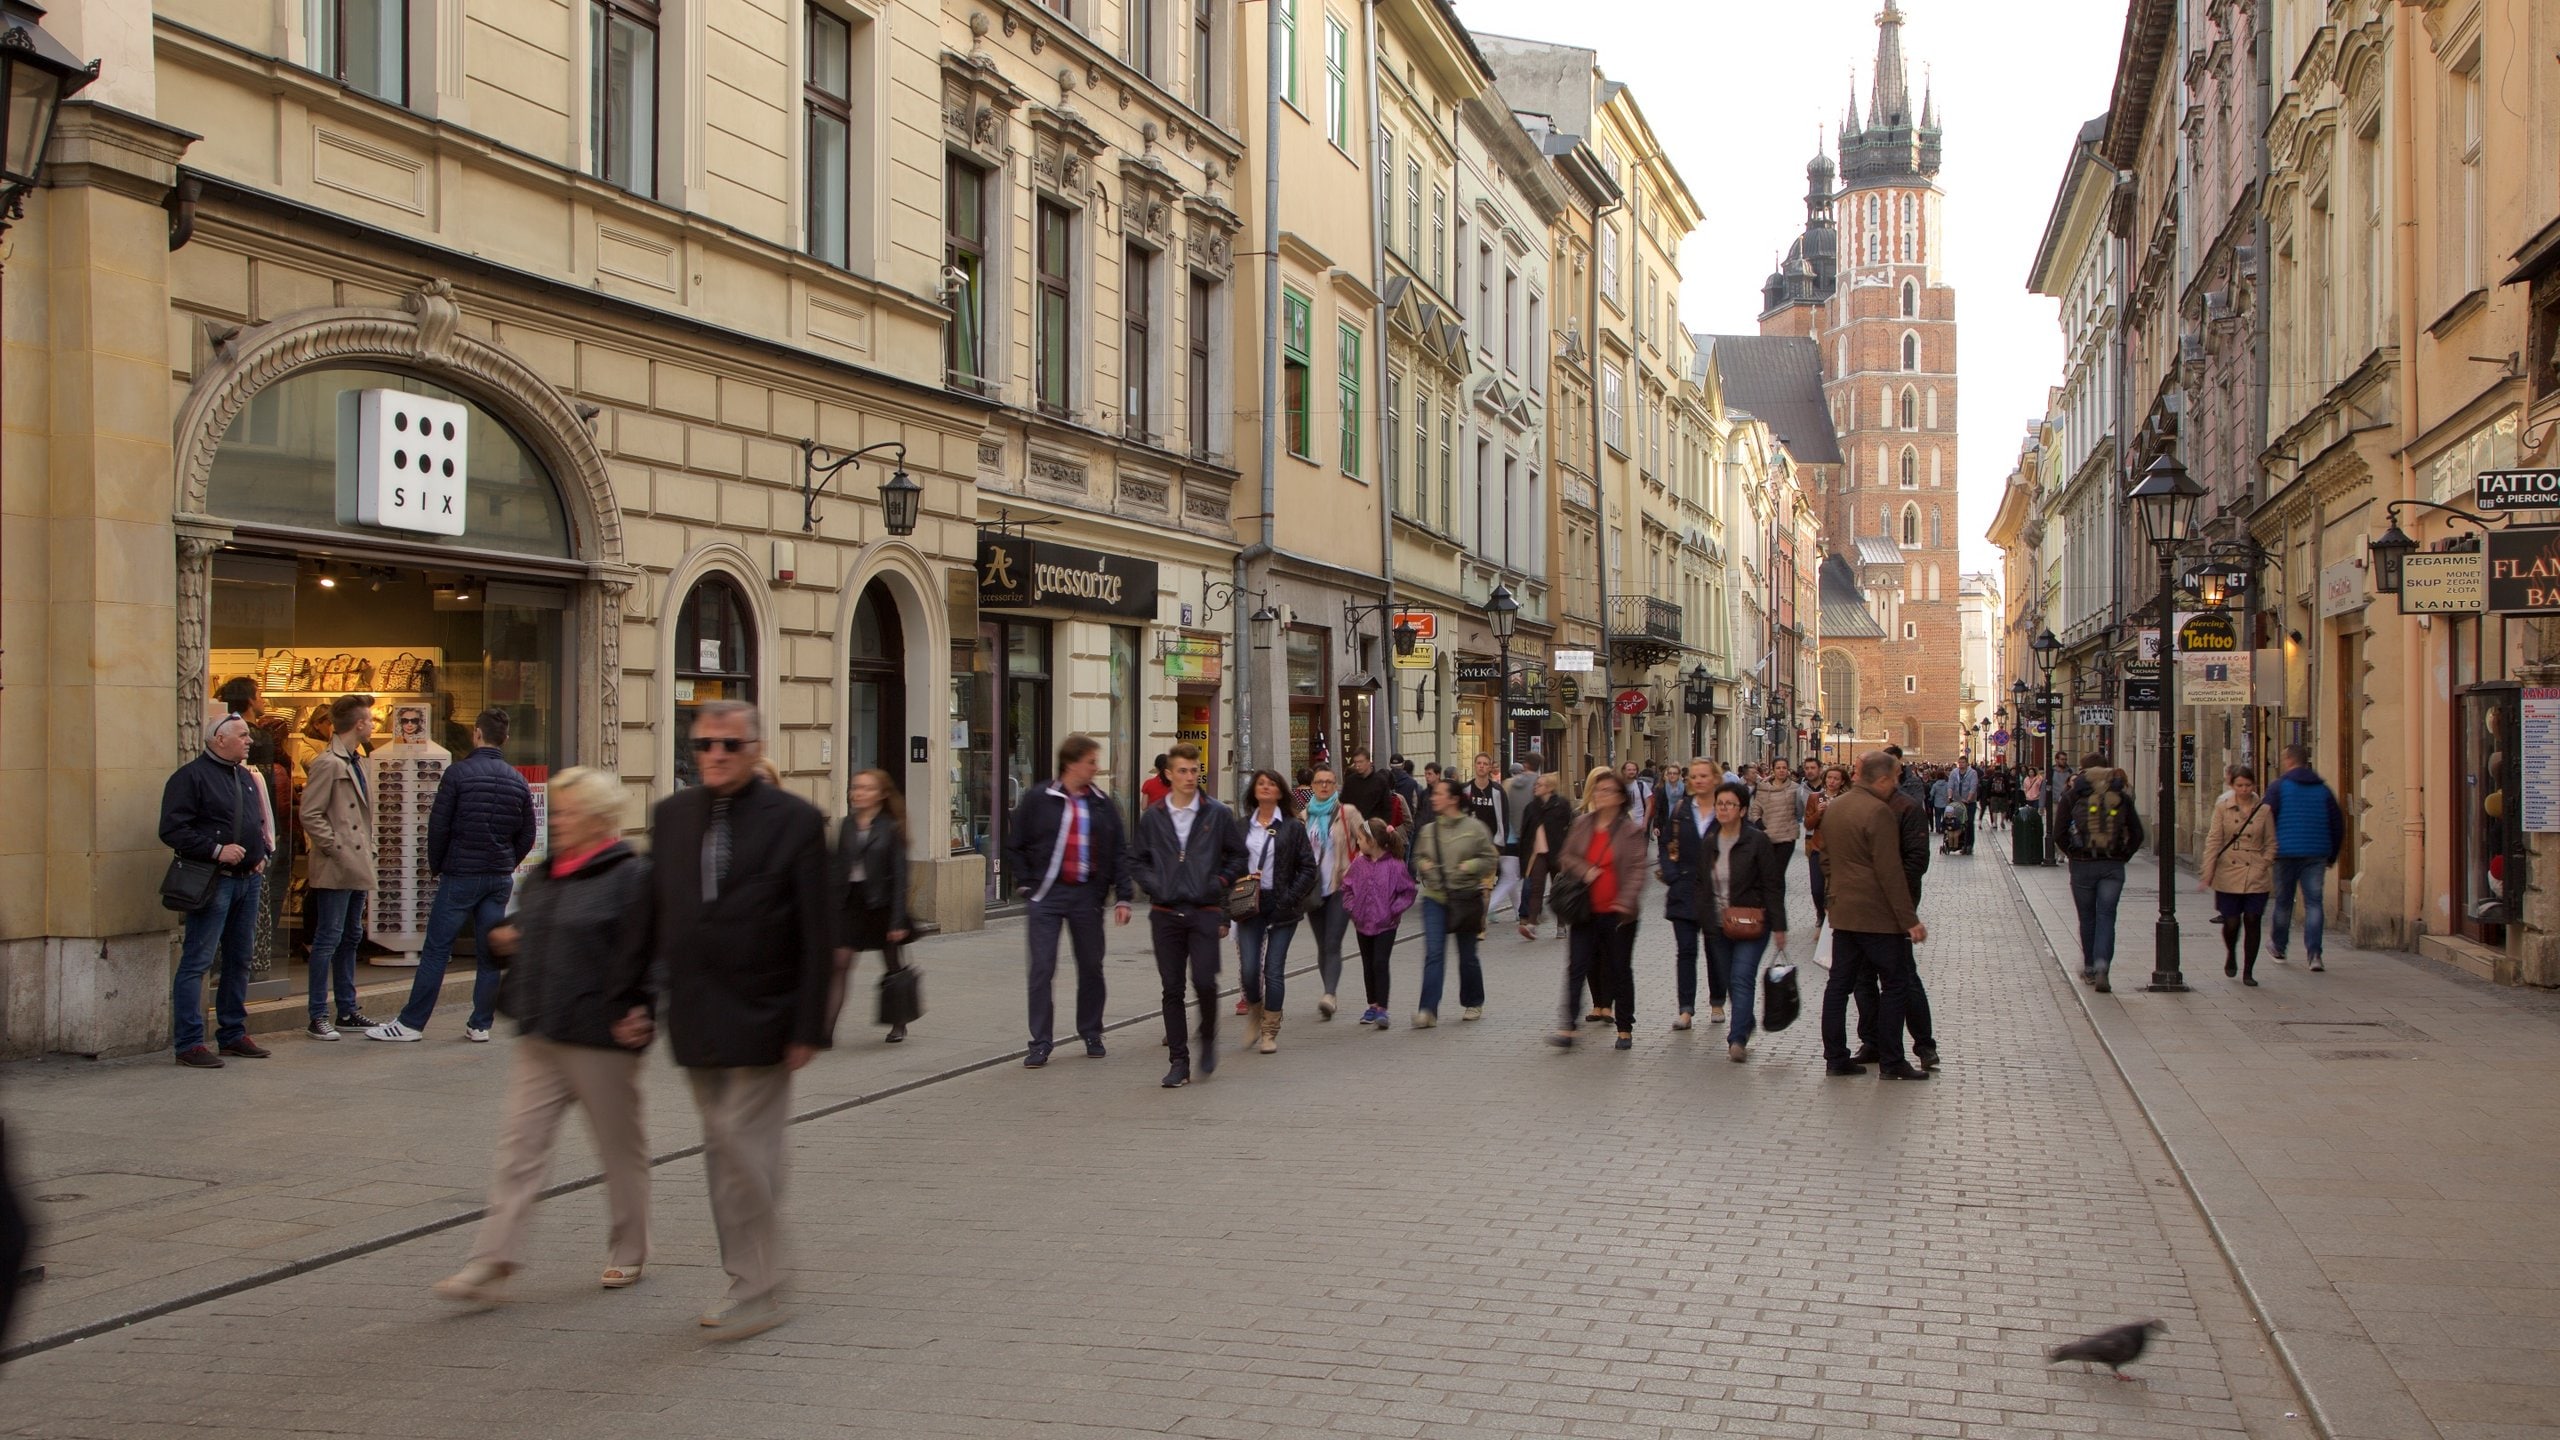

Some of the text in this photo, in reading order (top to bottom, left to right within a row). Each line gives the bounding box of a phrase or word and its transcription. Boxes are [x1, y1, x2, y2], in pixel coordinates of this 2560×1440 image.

[2478, 474, 2560, 492] TATTO
[394, 487, 452, 515] SIX
[2496, 493, 2559, 504] & PIERCING
[980, 545, 1018, 589] A
[2185, 573, 2247, 588] INNET
[2406, 579, 2441, 587] SKUP
[2446, 586, 2477, 594] ZŁOTA
[2190, 620, 2225, 629] piercing
[2183, 629, 2233, 649] Tattoo
[1511, 707, 1550, 717] Alkohole
[2080, 709, 2114, 724] TATTOO
[1342, 698, 1352, 765] MONETY
